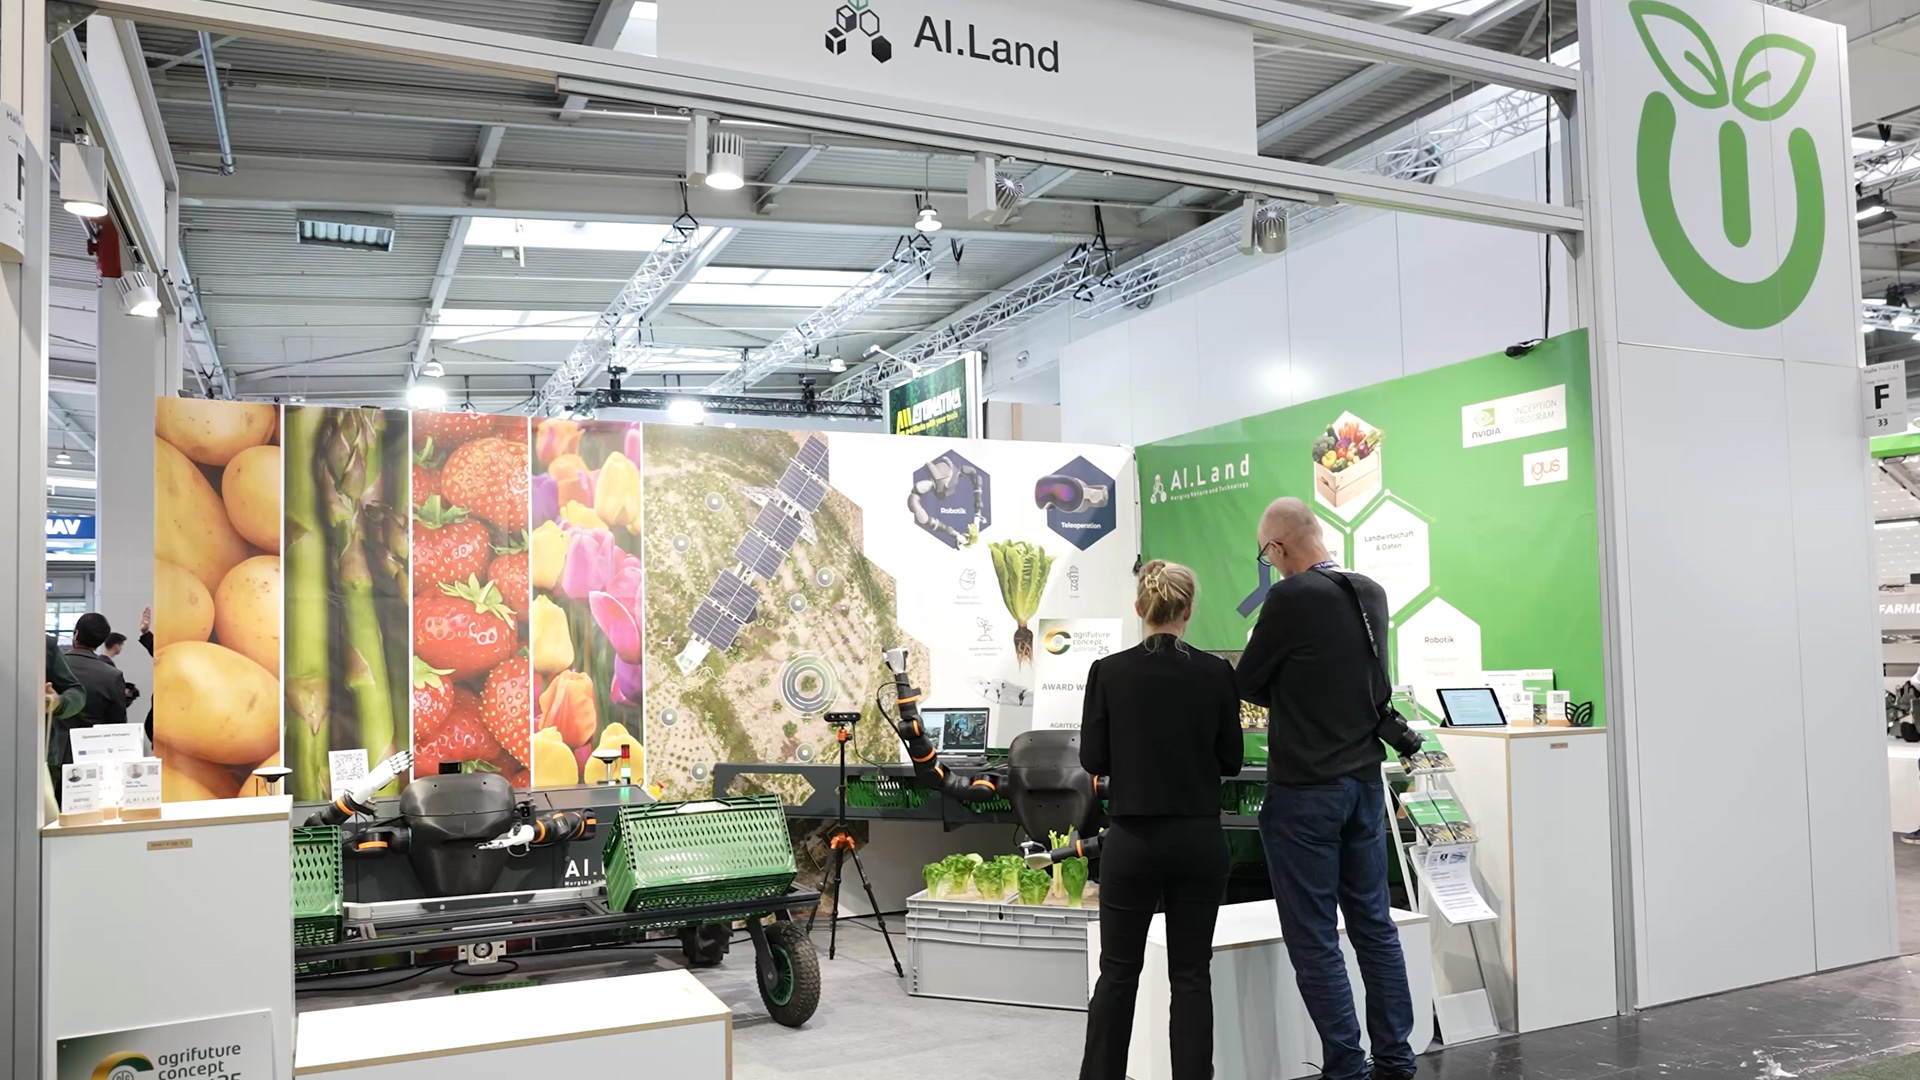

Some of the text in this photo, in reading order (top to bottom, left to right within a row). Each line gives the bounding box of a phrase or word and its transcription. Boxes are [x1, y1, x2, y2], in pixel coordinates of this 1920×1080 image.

[914, 15, 1059, 73] AI.Land
[1874, 384, 1889, 410] F
[1515, 399, 1557, 415] INCEPTION
[1515, 411, 1554, 425] PROGRAM
[1878, 418, 1888, 427] 33
[1170, 453, 1250, 491] AI.Land
[1531, 459, 1560, 481] igus
[941, 507, 967, 515] Robotik
[1061, 521, 1102, 530] Teleoperation
[1364, 531, 1414, 543] Landwirtschaft
[1382, 543, 1402, 551] Daten
[1073, 631, 1111, 639] agrifuture
[1042, 683, 1074, 691] AWARD
[565, 858, 605, 878] AI.
[158, 1044, 242, 1067] agrifuture
[158, 1060, 225, 1080] concept
